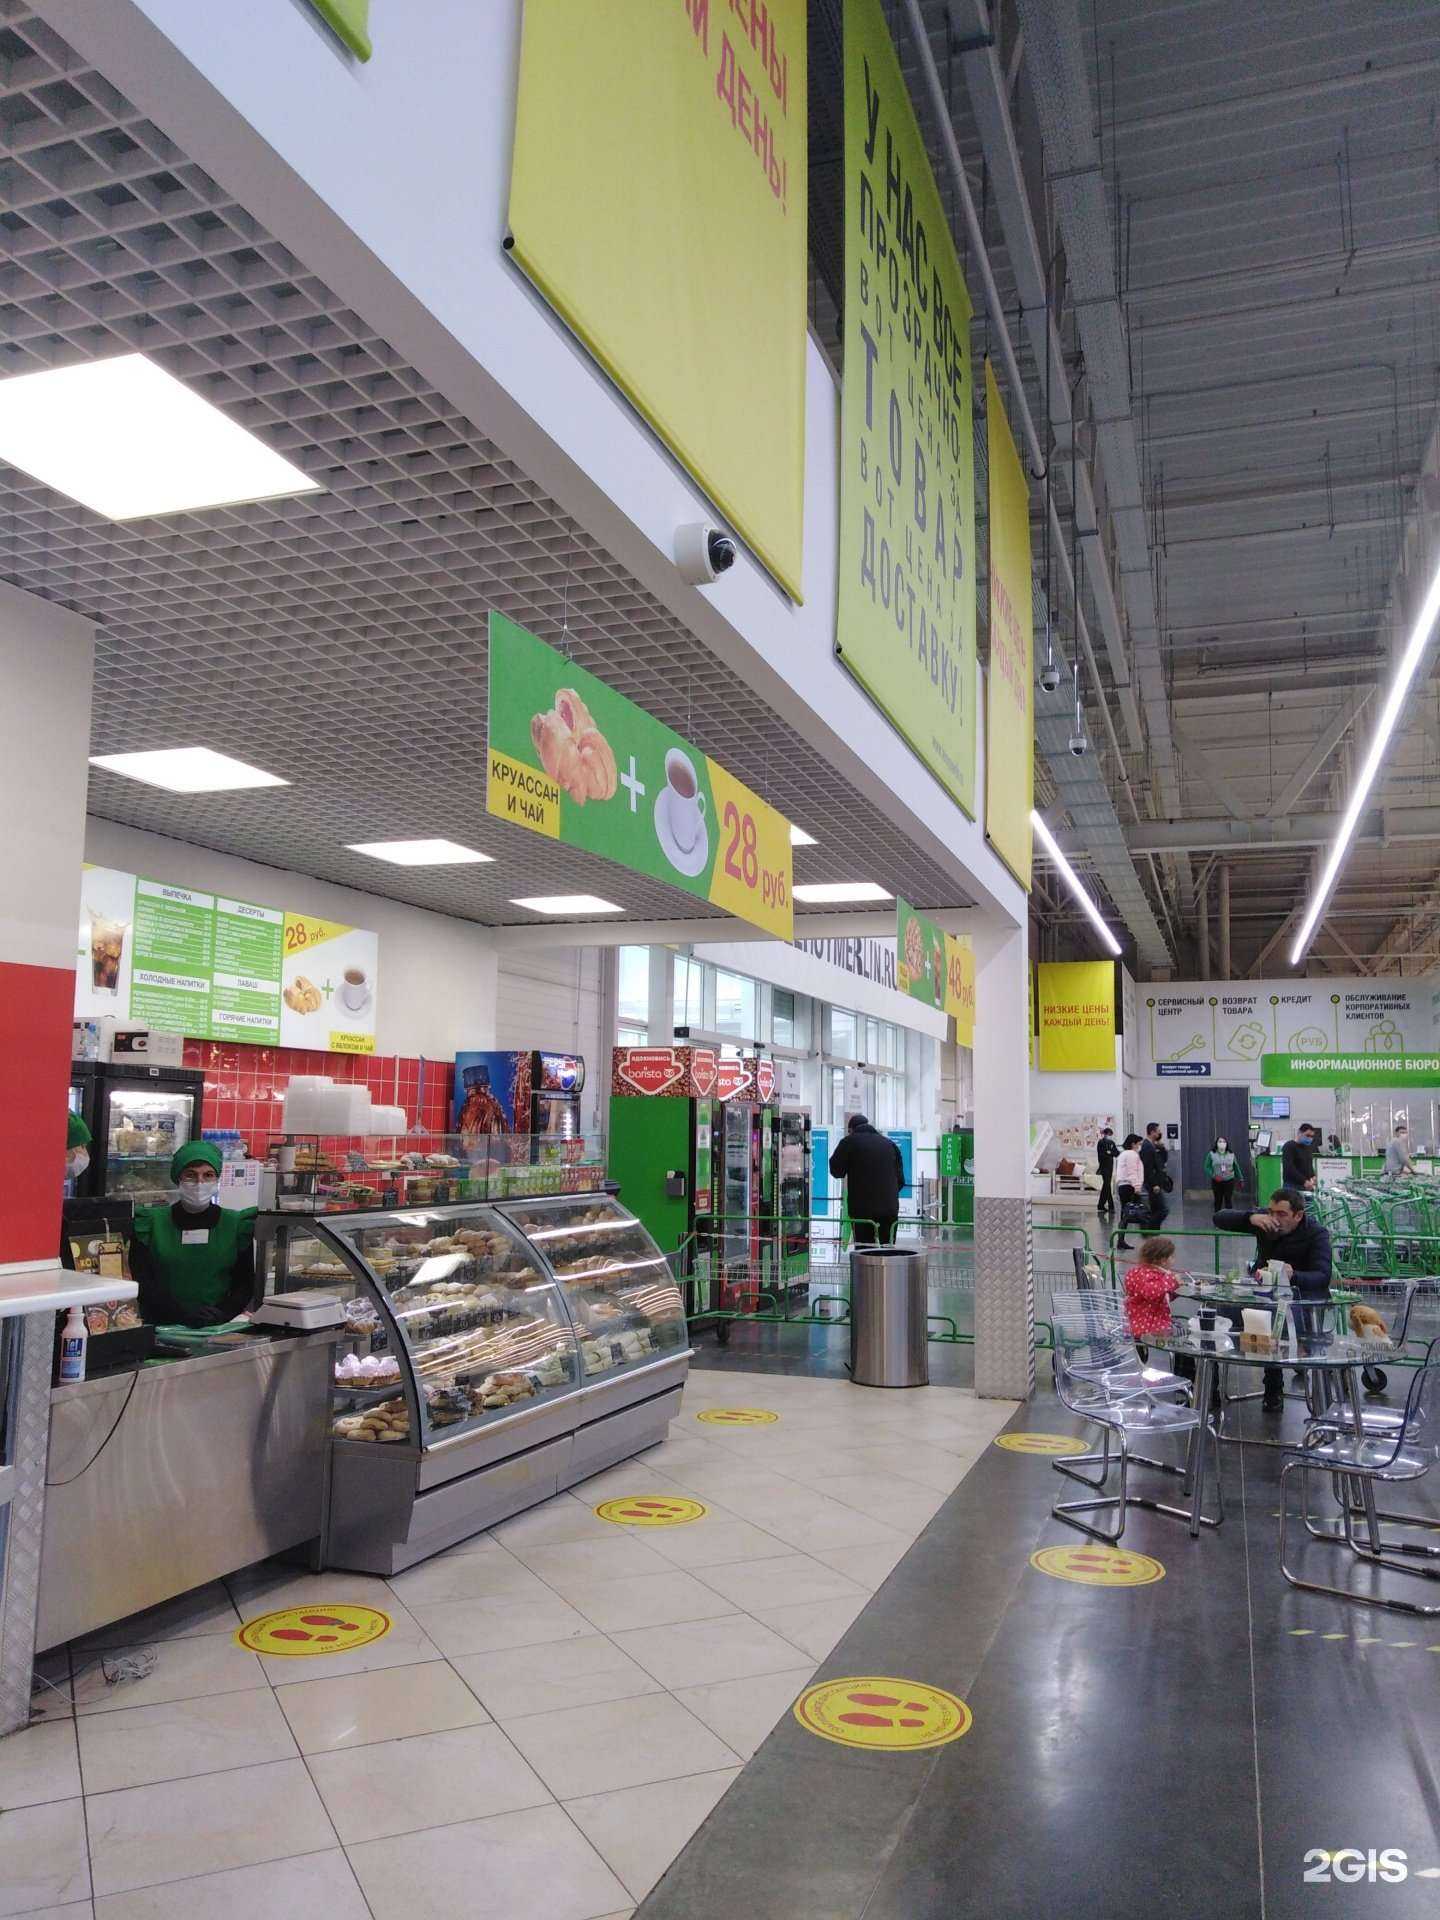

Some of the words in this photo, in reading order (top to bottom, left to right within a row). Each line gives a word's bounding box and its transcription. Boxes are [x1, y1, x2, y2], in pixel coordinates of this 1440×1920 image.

[717, 28, 787, 216] ДЕНЬ!
[885, 126, 928, 313] НАС
[932, 264, 963, 410] ВСЕ
[860, 258, 894, 362] ВОТ
[860, 319, 964, 602] ТОВАР
[860, 436, 895, 529] ВОТ
[861, 505, 964, 728] ДОСТАВКУ!
[491, 759, 560, 805] КРУАССАН
[507, 795, 517, 812] И
[518, 797, 545, 825] ЧАЙ
[723, 800, 759, 889] 28
[762, 869, 790, 910] руб.
[162, 888, 192, 901] ВЫПЕЧКА
[237, 905, 265, 918] ДЕСЕРТЫ
[285, 923, 307, 950] 28
[948, 956, 962, 1000] 48
[1043, 1004, 1080, 1015] НИЗКИЕ
[1082, 1004, 1109, 1015] ЦЕНЫ
[1157, 997, 1205, 1007] СЕРВИСНЫЙ
[1222, 996, 1257, 1006] ВОЗВРАТ
[1281, 995, 1312, 1004] КРЕДИТ
[1157, 1008, 1182, 1017] ЦЕНТР
[1222, 1006, 1254, 1015] ТОВАРА
[1345, 1012, 1385, 1020] КЛИЕНТОВ
[1043, 1017, 1082, 1028] КАЖДЫЙ
[1290, 1058, 1402, 1072] ИНФОРМАЦИОННОЕ
[1405, 1059, 1439, 1070] БЮРО
